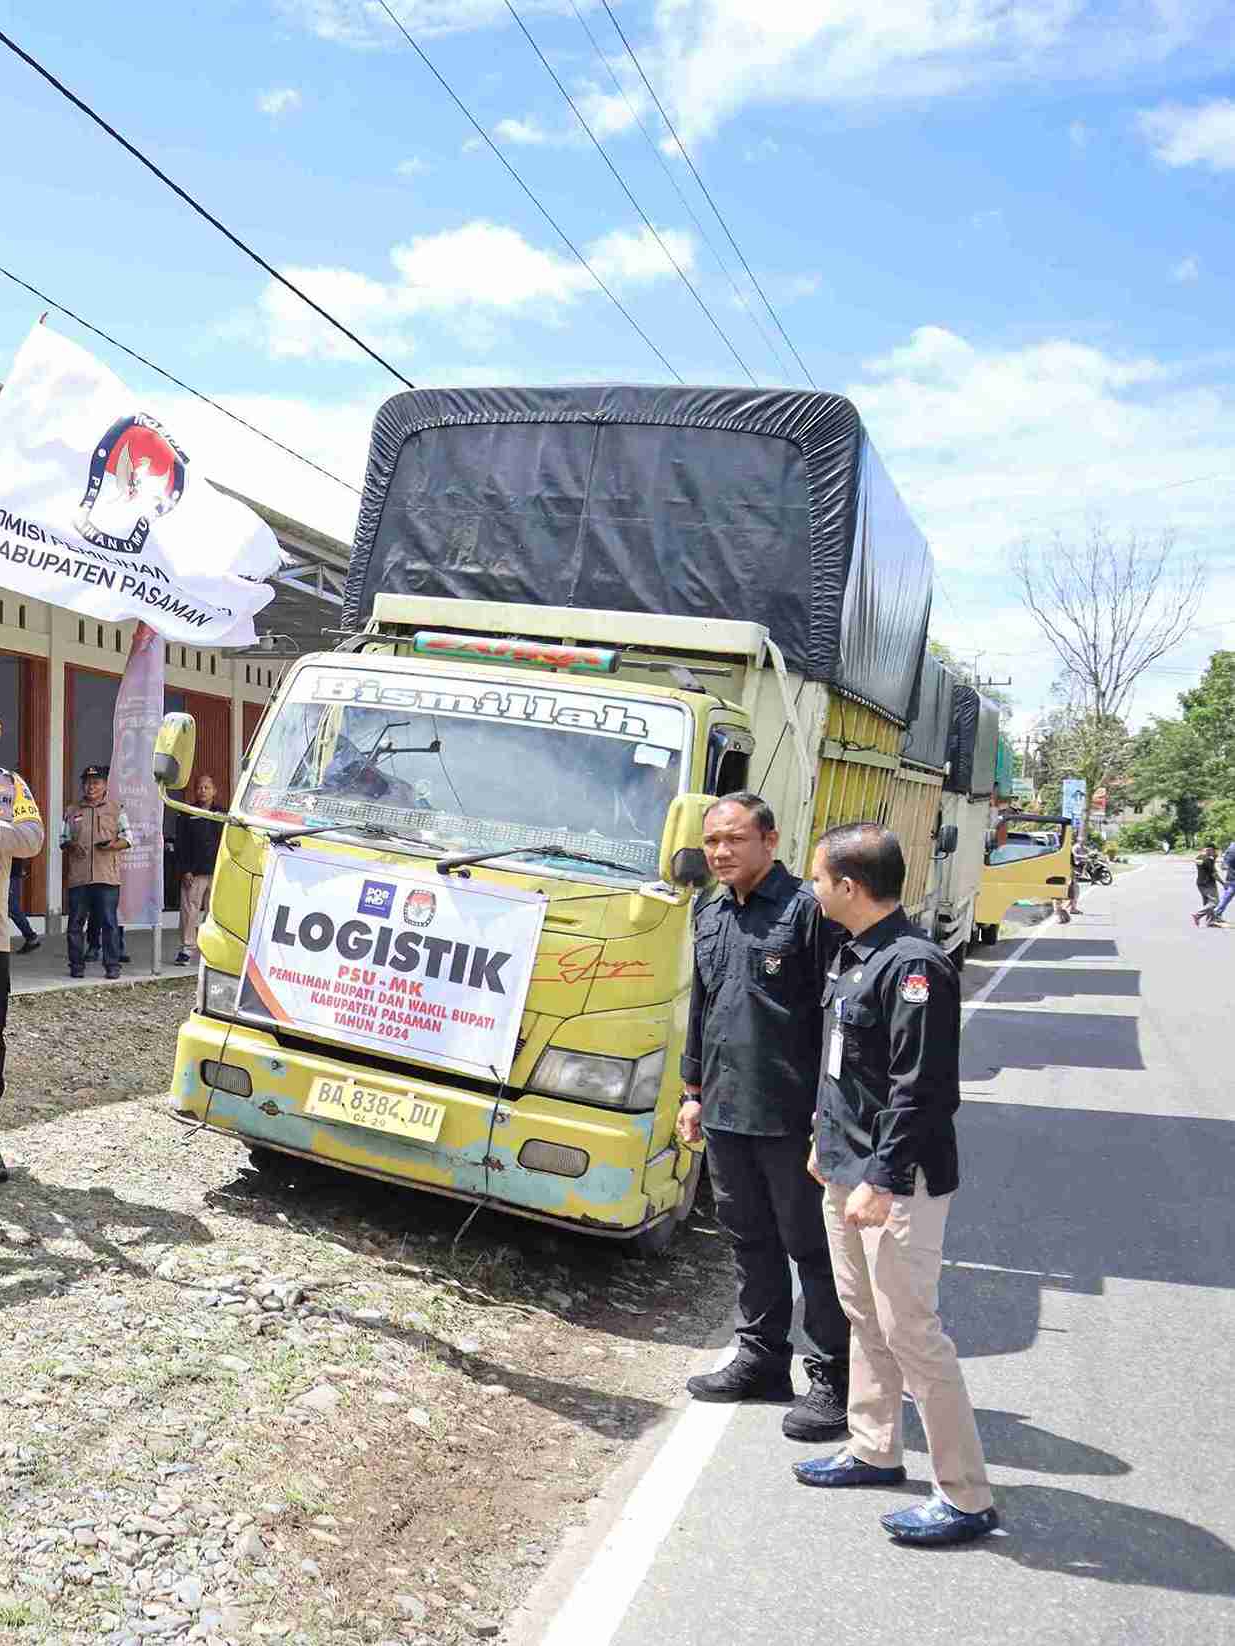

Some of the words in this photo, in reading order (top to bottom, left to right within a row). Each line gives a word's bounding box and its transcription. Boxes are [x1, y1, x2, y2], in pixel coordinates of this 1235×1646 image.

[119, 574, 213, 627] PASAMAN
[311, 676, 649, 738] Bismillah
[270, 903, 513, 995] LOGISTIK
[269, 966, 331, 990] PEMILIHAN
[333, 981, 375, 1002] BUPATI
[378, 991, 405, 1009] DAN
[408, 998, 448, 1019] WAKIL
[451, 1008, 495, 1030] BUPATI
[337, 964, 377, 986] PSU
[388, 976, 424, 998] MK
[310, 991, 378, 1018] KABUPATEN
[381, 1008, 442, 1033] PASAMAN
[333, 1012, 375, 1034] TAHUN
[378, 1022, 409, 1041] 2024
[317, 1082, 344, 1105] BA
[350, 1090, 401, 1120] 8384
[407, 1103, 439, 1128] DU
